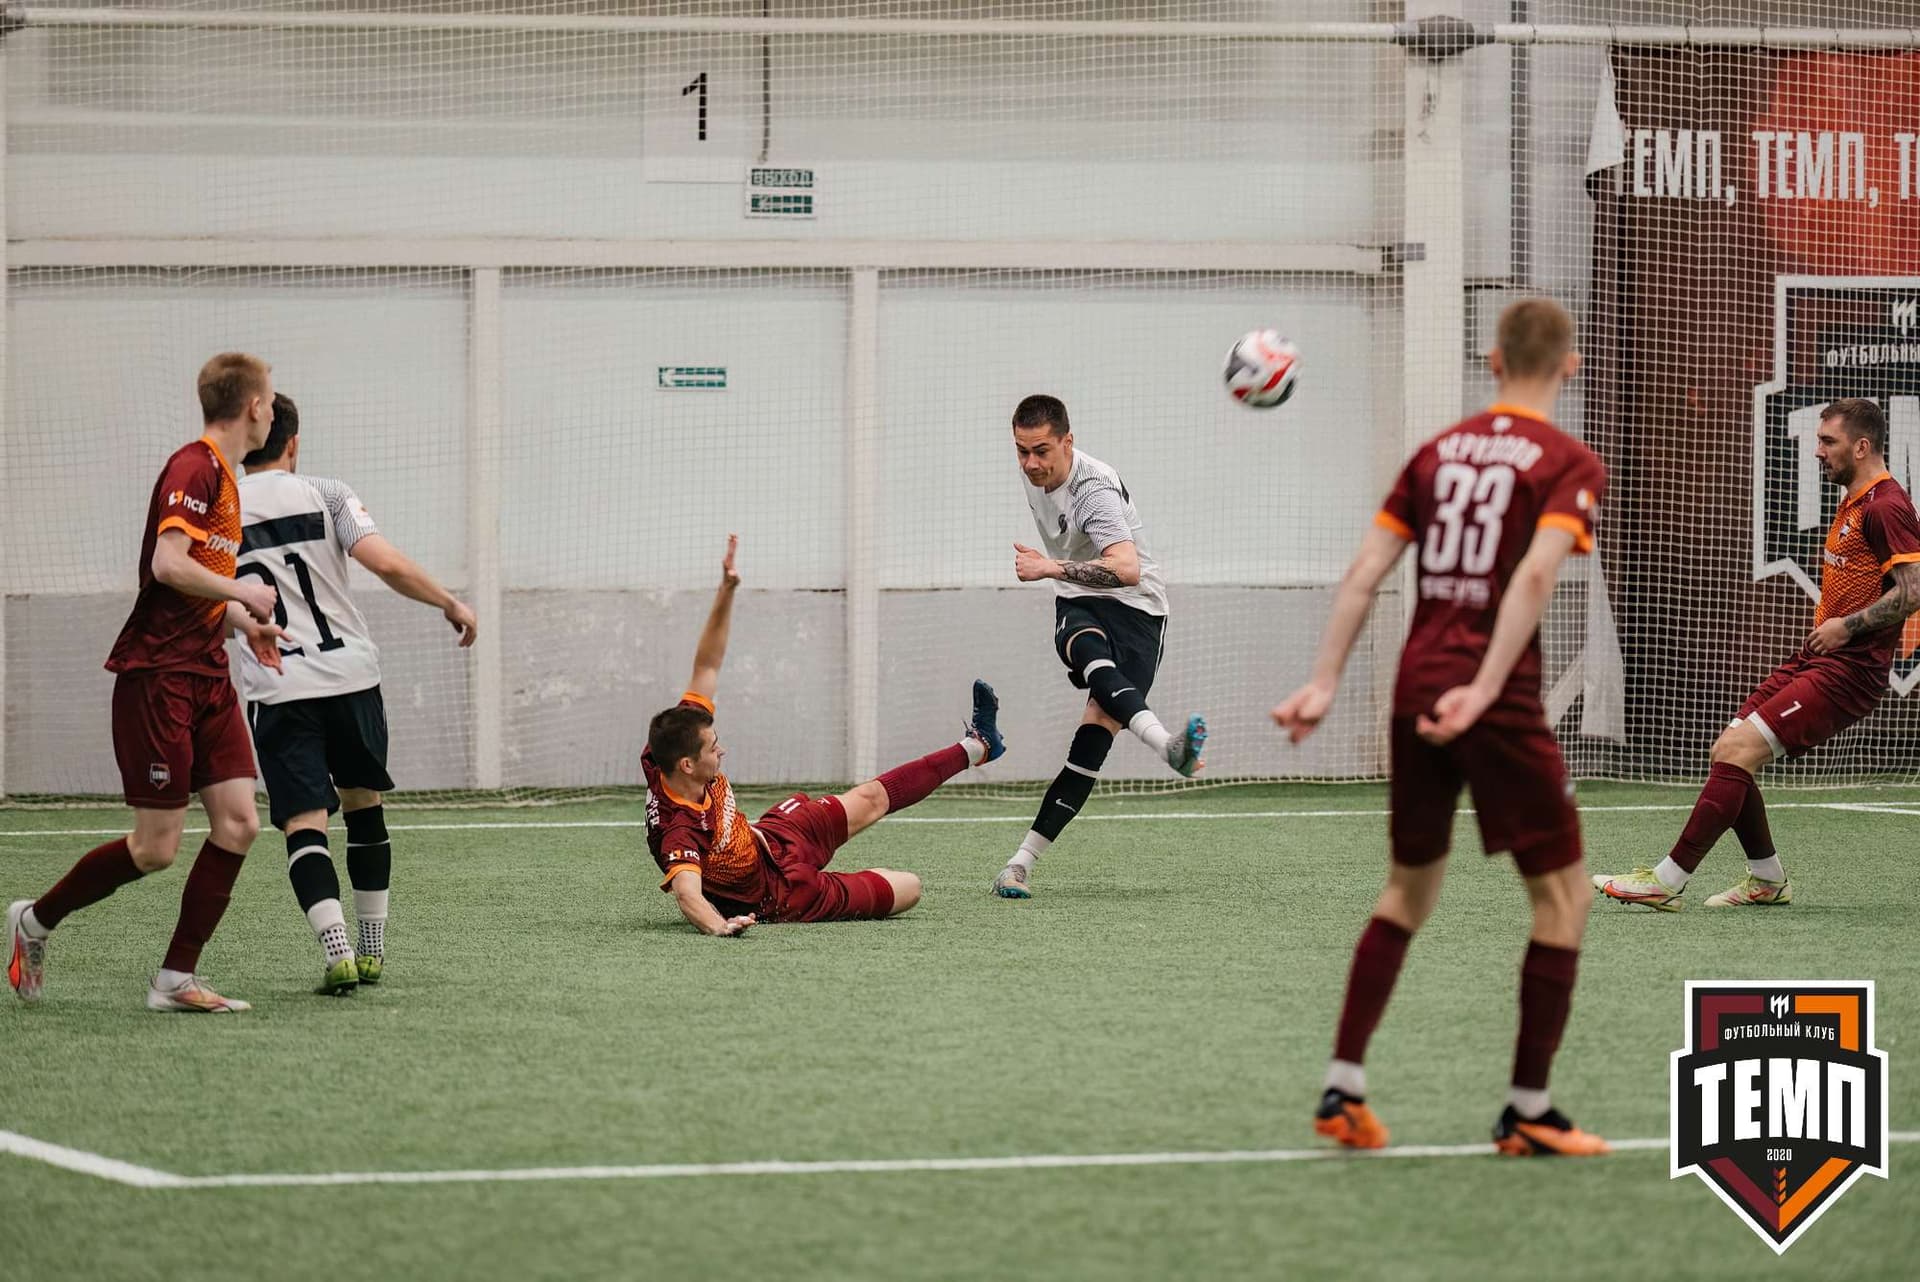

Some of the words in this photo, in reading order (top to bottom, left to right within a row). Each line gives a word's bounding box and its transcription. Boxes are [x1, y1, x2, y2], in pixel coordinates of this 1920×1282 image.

[682, 72, 707, 140] 1
[1752, 131, 1879, 208] ТЕМП,
[1421, 463, 1516, 575] 33
